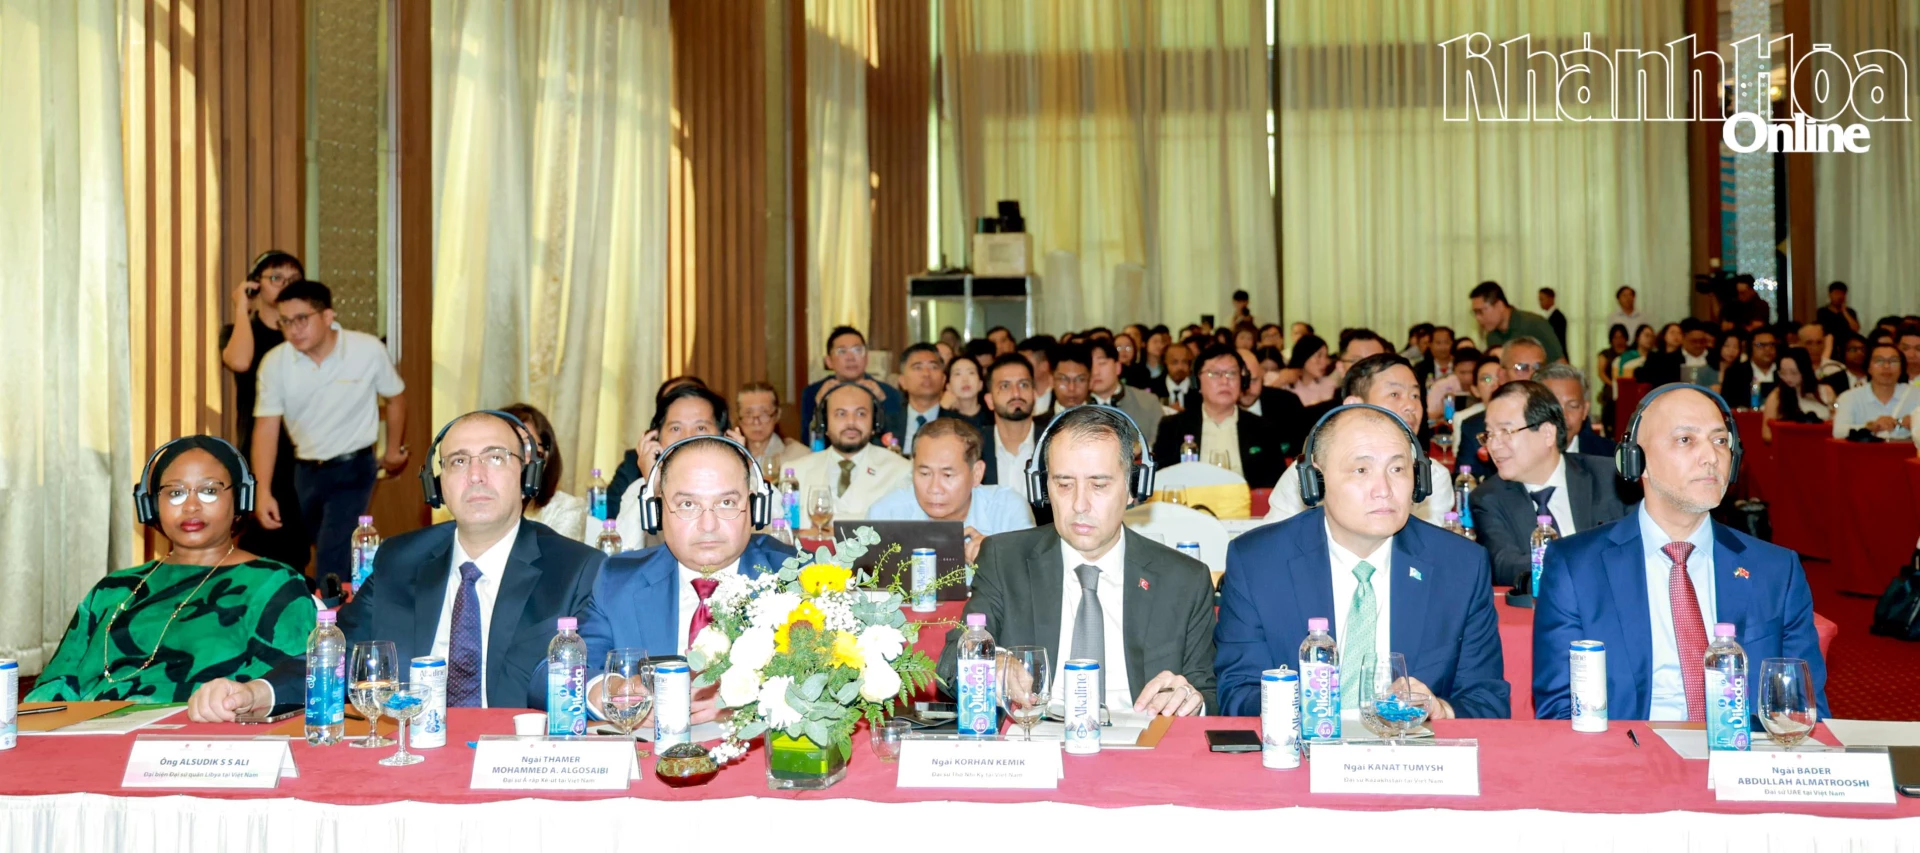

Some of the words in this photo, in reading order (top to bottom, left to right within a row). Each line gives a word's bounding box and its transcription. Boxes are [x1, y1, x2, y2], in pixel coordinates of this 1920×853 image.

[1075, 673, 1088, 719] Alkaline
[159, 757, 178, 767] Ông
[179, 758, 219, 766] ALSUDIK
[220, 758, 226, 766] S
[954, 758, 994, 766] KORHAN
[492, 766, 548, 774] MOHAMMED
[560, 767, 609, 775] ALGOSAIBI
[1367, 763, 1401, 771] KANAT
[1402, 764, 1444, 772] TUMYSH
[1771, 766, 1795, 776] Ngài
[1797, 767, 1832, 775] BADER
[204, 771, 221, 779] Libya
[1737, 777, 1793, 786] ABDULLAH
[1795, 778, 1870, 787] ALMATROOSHI
